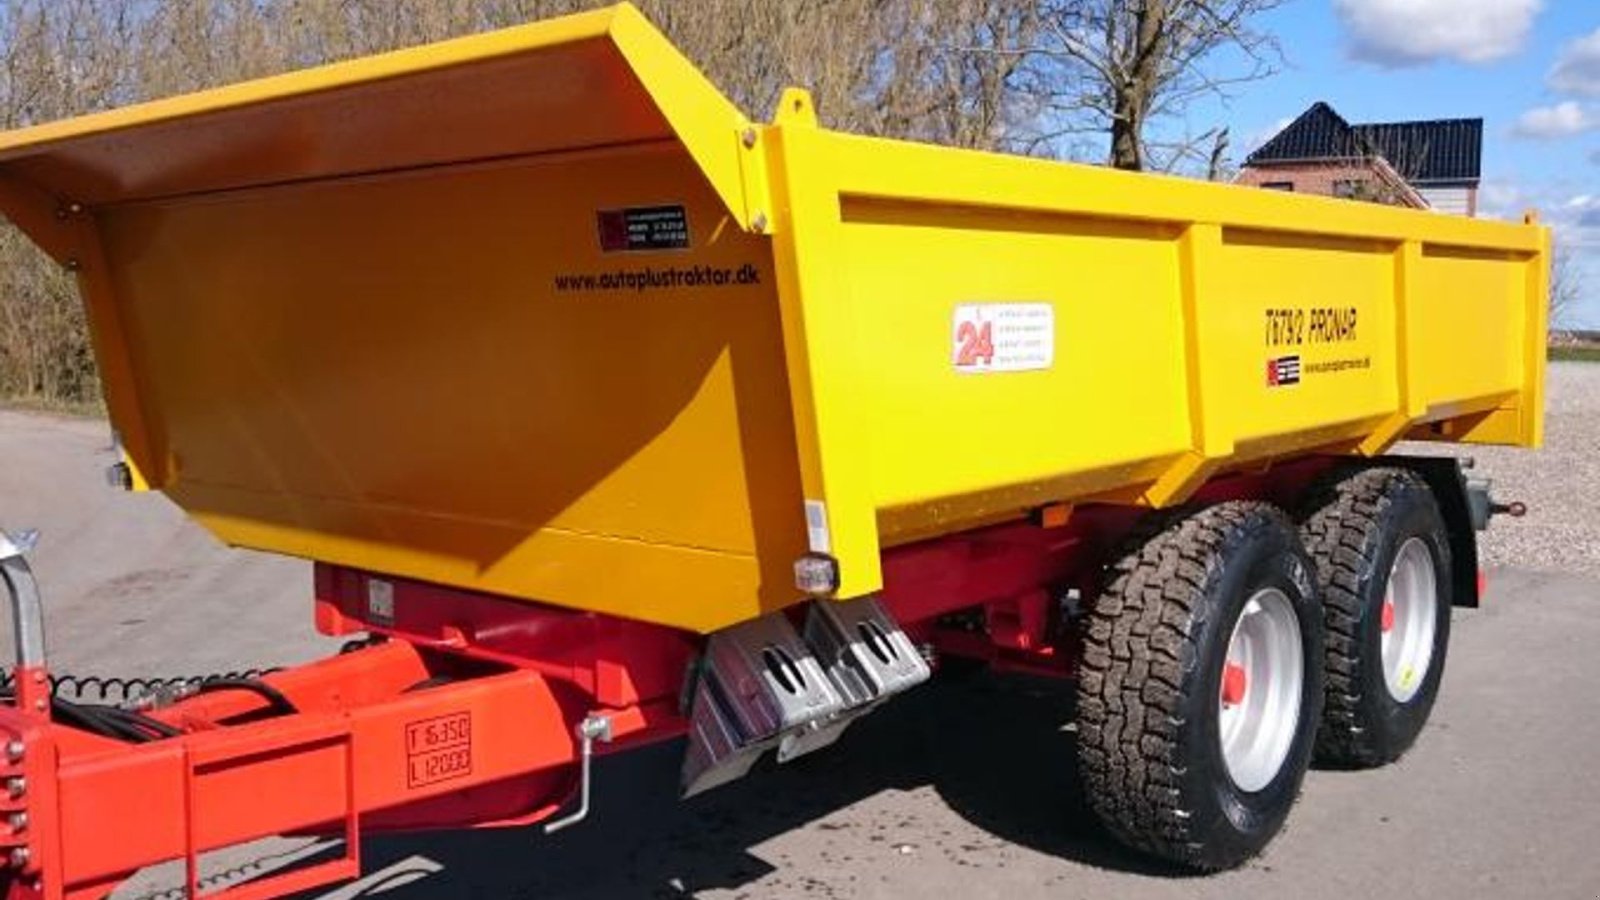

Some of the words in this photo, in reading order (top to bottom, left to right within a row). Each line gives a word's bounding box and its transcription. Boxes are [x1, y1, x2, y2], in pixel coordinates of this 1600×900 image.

[1308, 307, 1357, 343] PRONAR
[956, 320, 994, 365] 24
[409, 728, 419, 750] T
[411, 761, 419, 783] L
